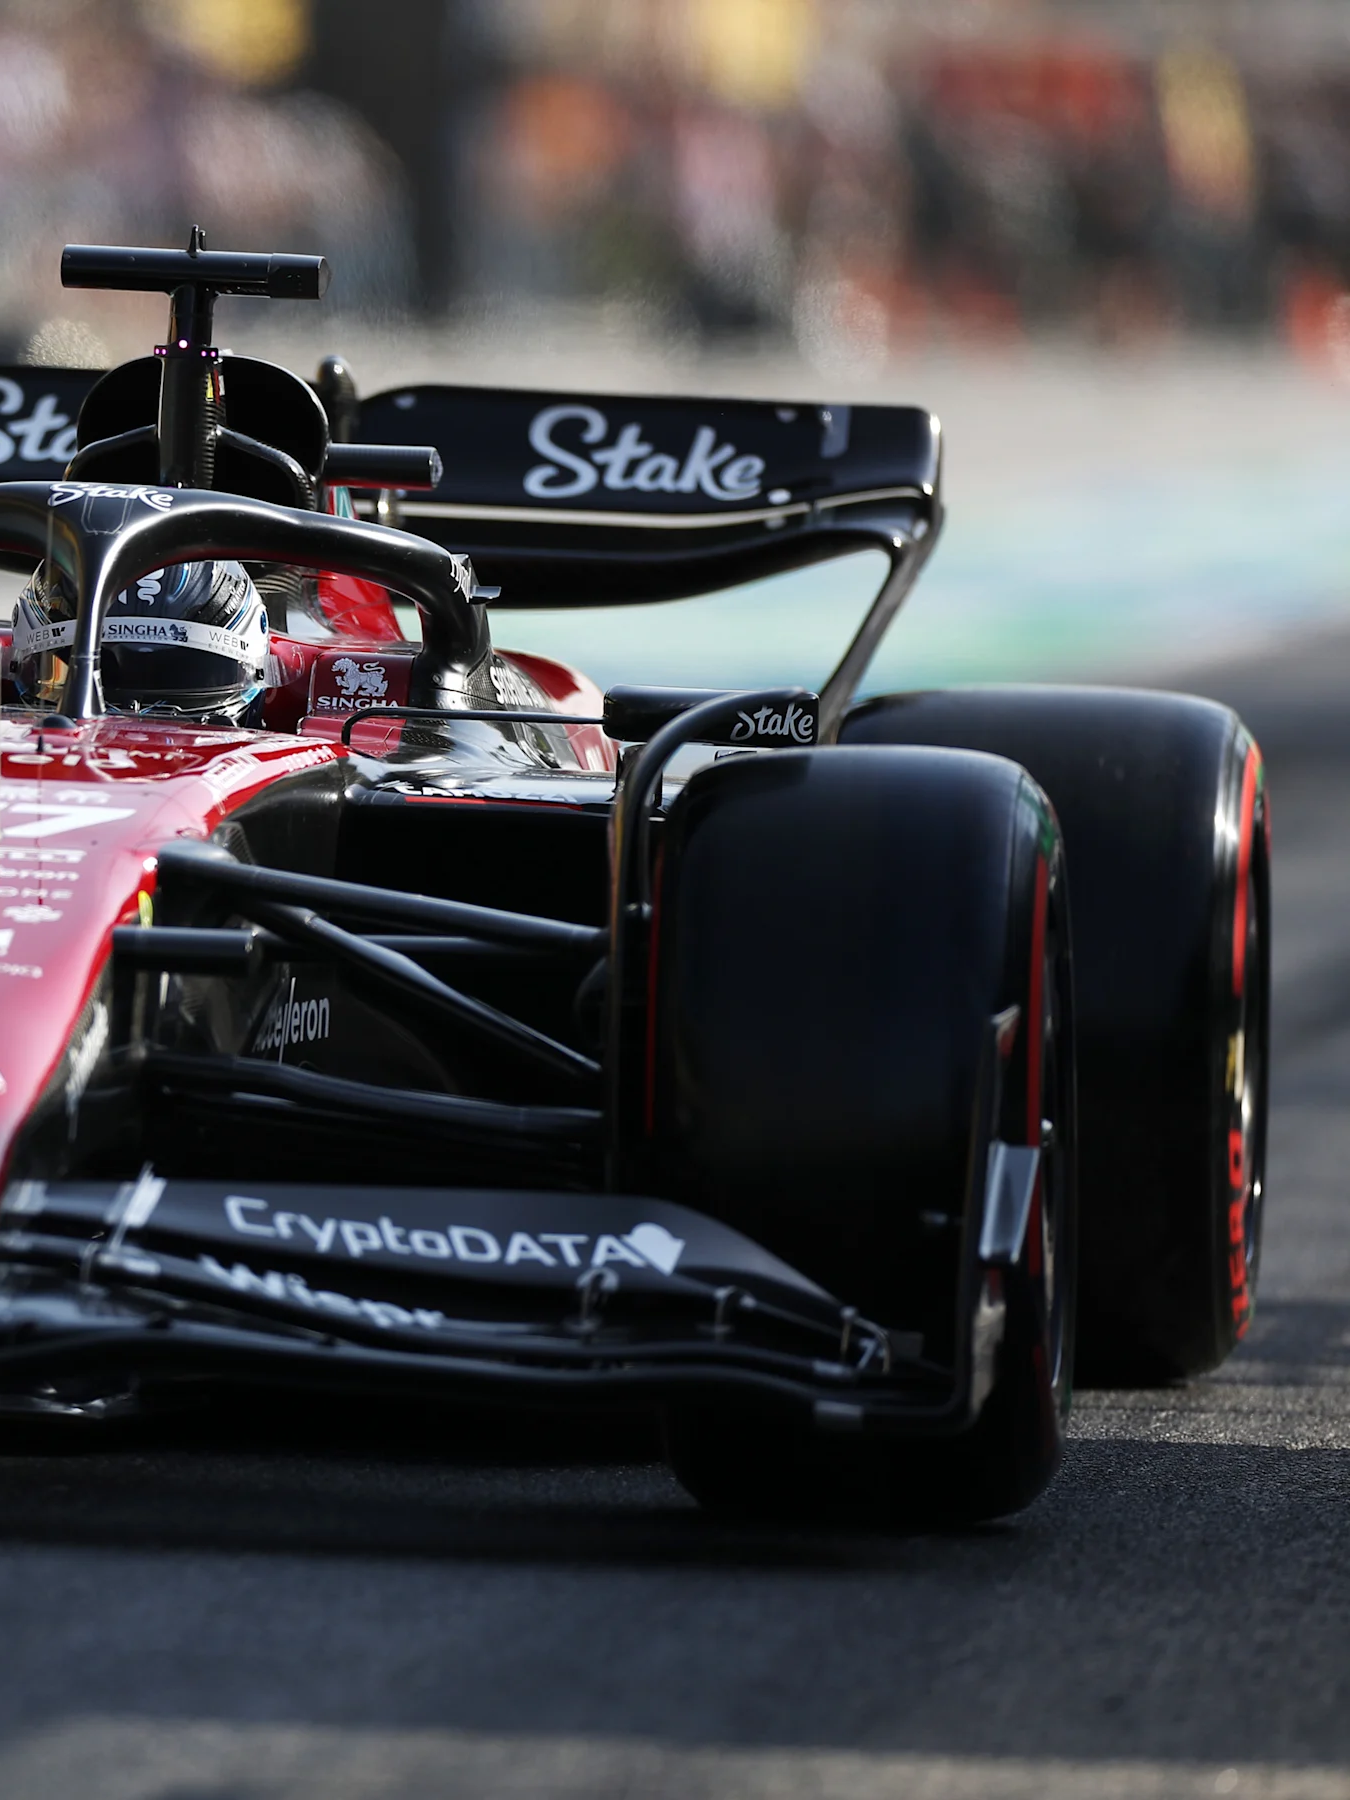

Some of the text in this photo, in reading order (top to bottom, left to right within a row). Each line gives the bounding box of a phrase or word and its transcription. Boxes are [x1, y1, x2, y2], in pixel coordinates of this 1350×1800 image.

[523, 404, 766, 500] Stake
[48, 482, 174, 512] Stake
[26, 630, 50, 645] WEB
[107, 624, 167, 636] SINGHA
[209, 630, 239, 648] WEB
[317, 696, 400, 709] SINGHA
[730, 703, 814, 743] Stake
[223, 1195, 650, 1270] CryptoDATA
